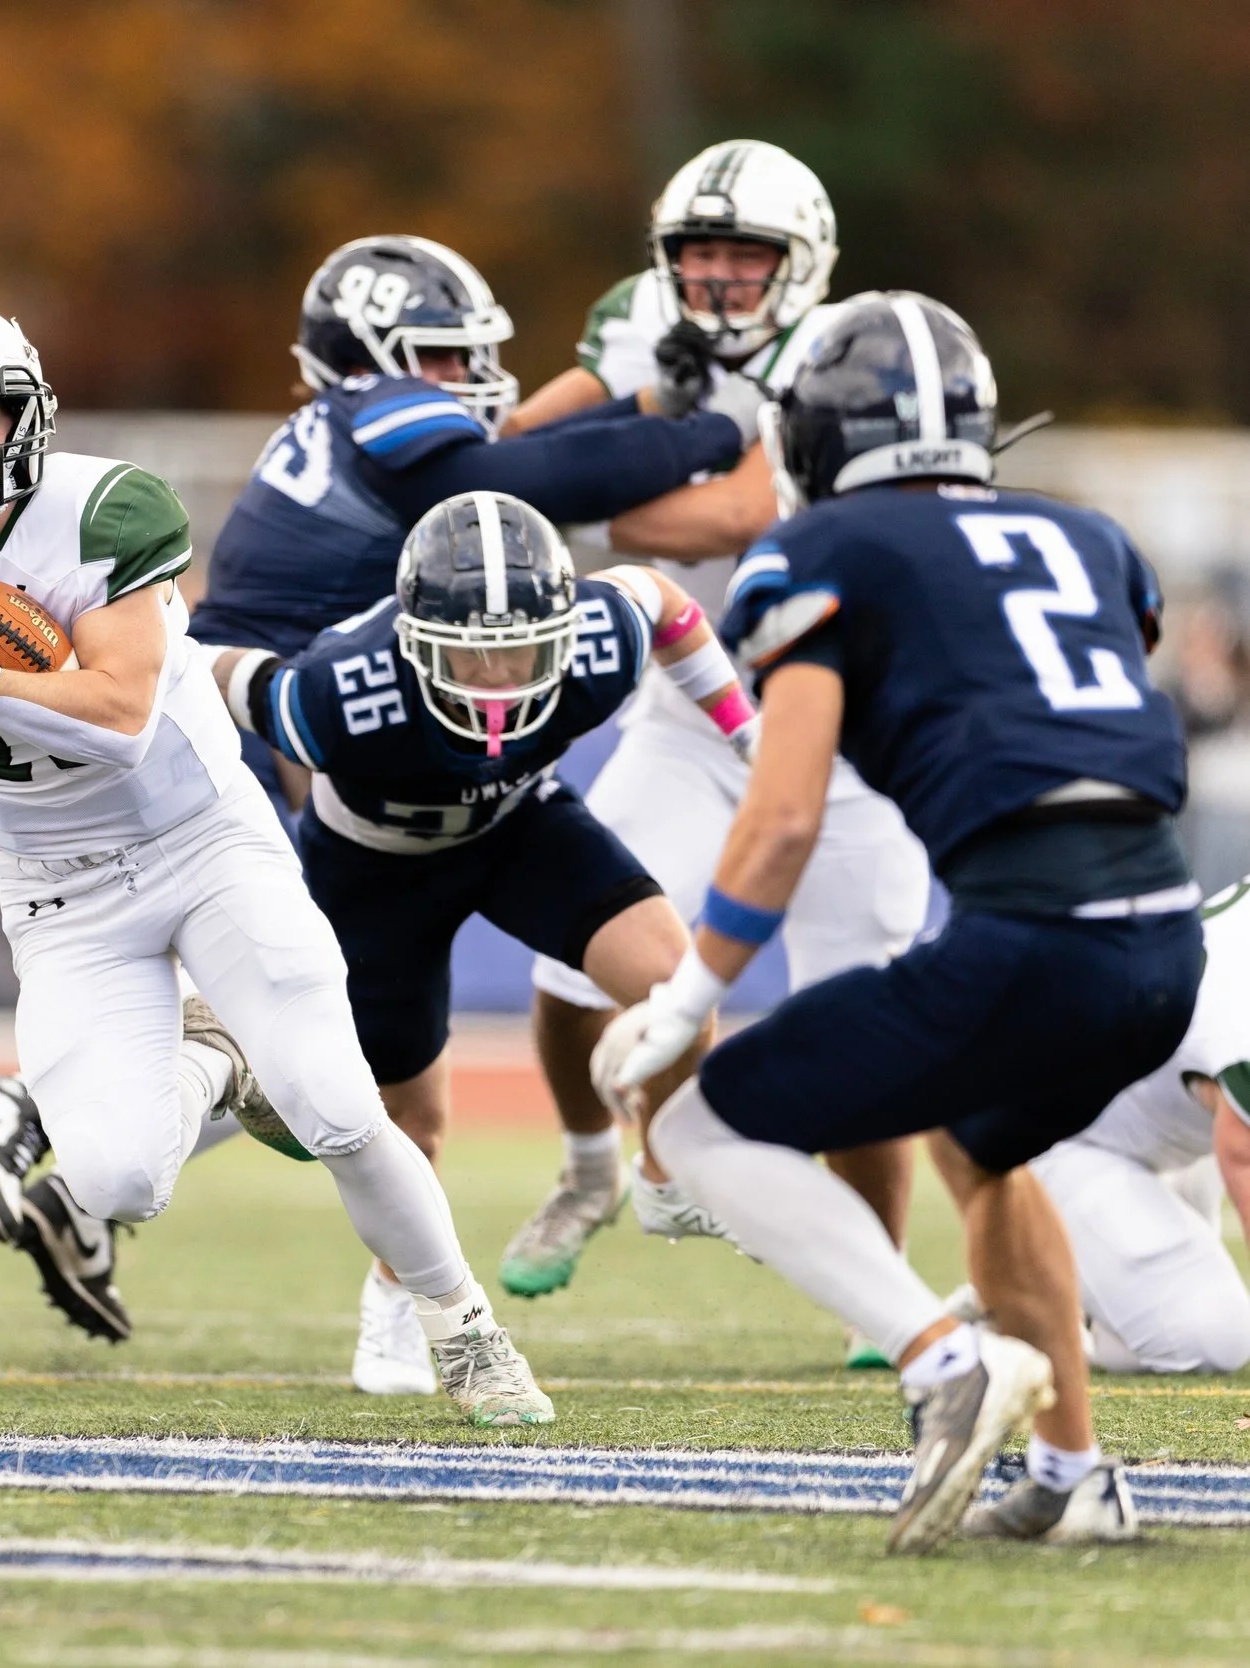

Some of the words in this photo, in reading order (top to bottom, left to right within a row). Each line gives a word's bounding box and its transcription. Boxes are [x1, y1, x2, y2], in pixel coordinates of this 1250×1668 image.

[333, 264, 410, 328] 99
[9, 595, 59, 648] Wilson
[954, 513, 1143, 711] 2
[332, 650, 407, 735] 26
